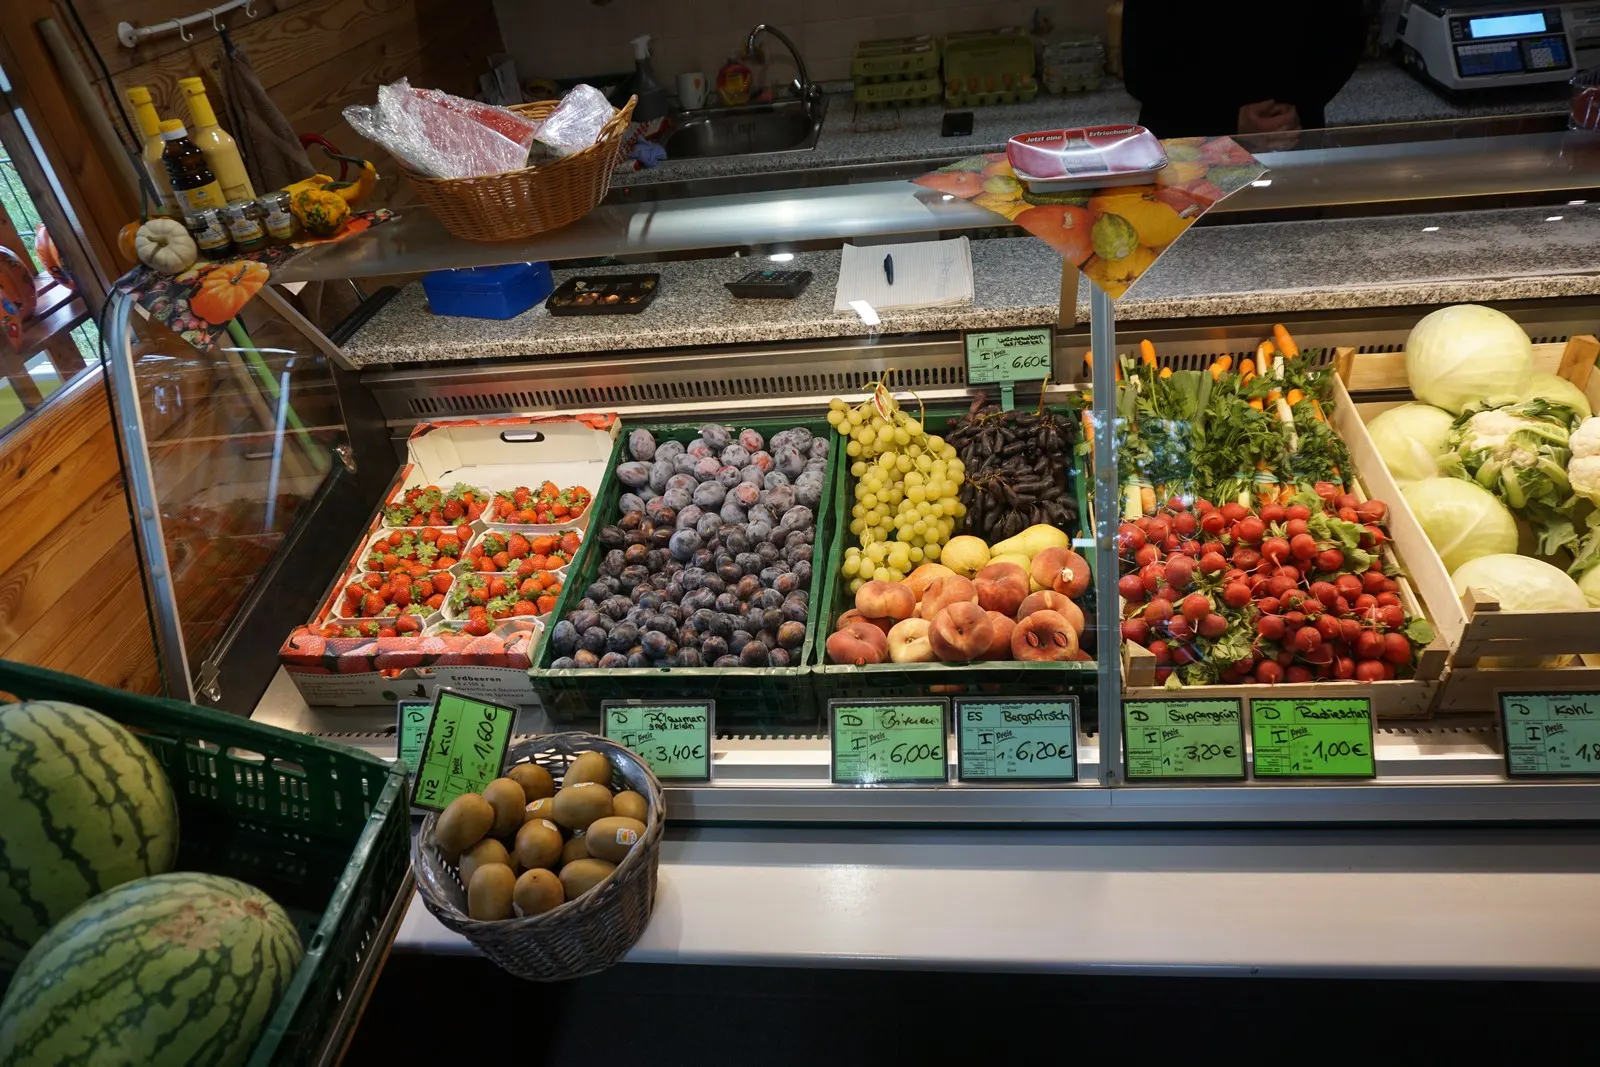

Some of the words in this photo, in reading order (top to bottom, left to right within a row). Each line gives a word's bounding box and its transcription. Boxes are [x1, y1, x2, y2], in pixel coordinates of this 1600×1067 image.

[1089, 127, 1135, 138] Erfrischung!
[977, 338, 989, 348] IT
[1012, 355, 1052, 368] 6,60€
[451, 675, 502, 683] Erdbeeren
[1130, 710, 1149, 721] D
[1256, 707, 1281, 720] D
[1555, 702, 1594, 716] Kohl
[408, 711, 425, 723] D
[611, 711, 628, 724] D
[840, 714, 863, 726] D
[967, 711, 983, 721] ES
[436, 719, 456, 757] Kiwi
[474, 706, 498, 760] 1,60€
[656, 745, 705, 764] 3,40€
[890, 742, 943, 765] 6,00€
[1016, 741, 1072, 763] 6,20€
[1312, 741, 1368, 762] 1,00€
